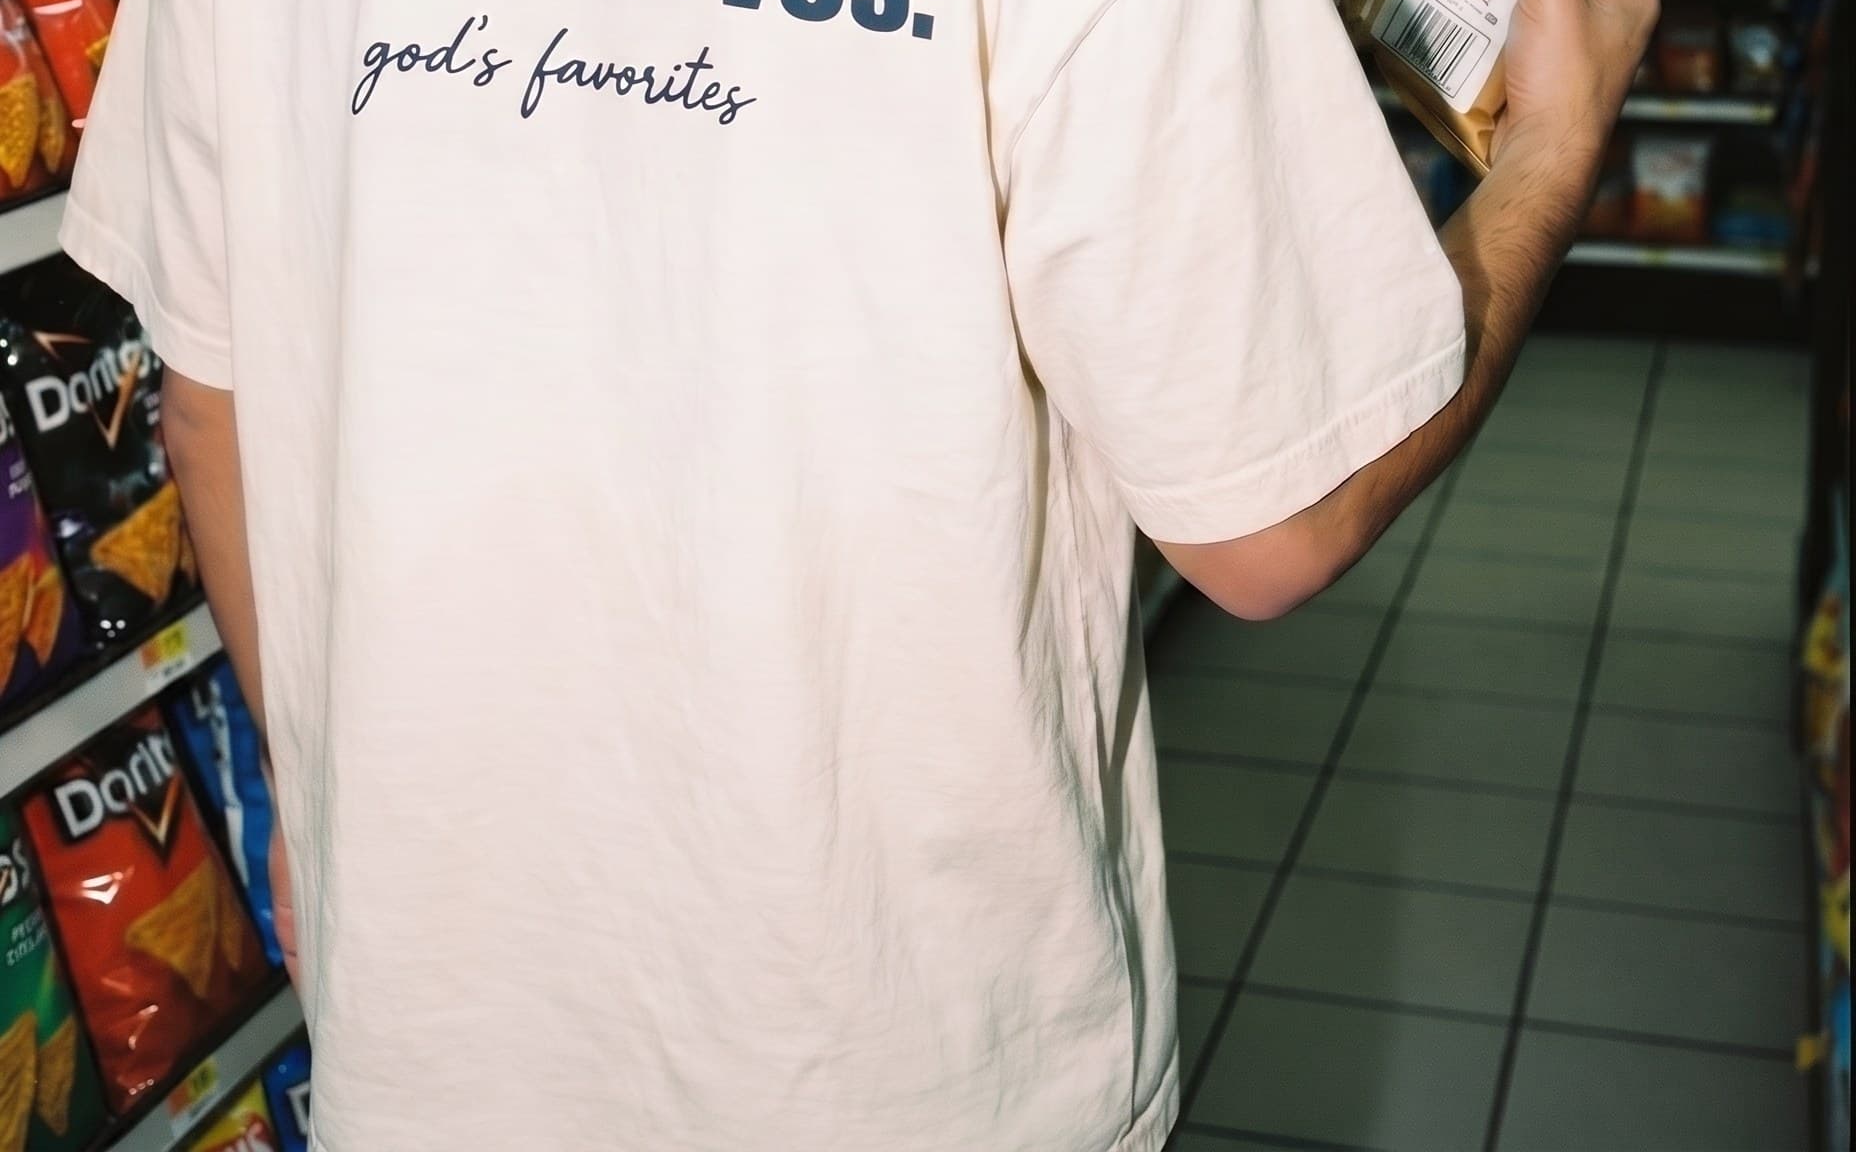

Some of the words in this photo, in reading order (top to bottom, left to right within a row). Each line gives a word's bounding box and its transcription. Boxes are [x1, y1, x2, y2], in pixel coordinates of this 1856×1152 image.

[352, 14, 513, 116] god's
[520, 28, 758, 125] favorites
[54, 734, 175, 838] Dorit
